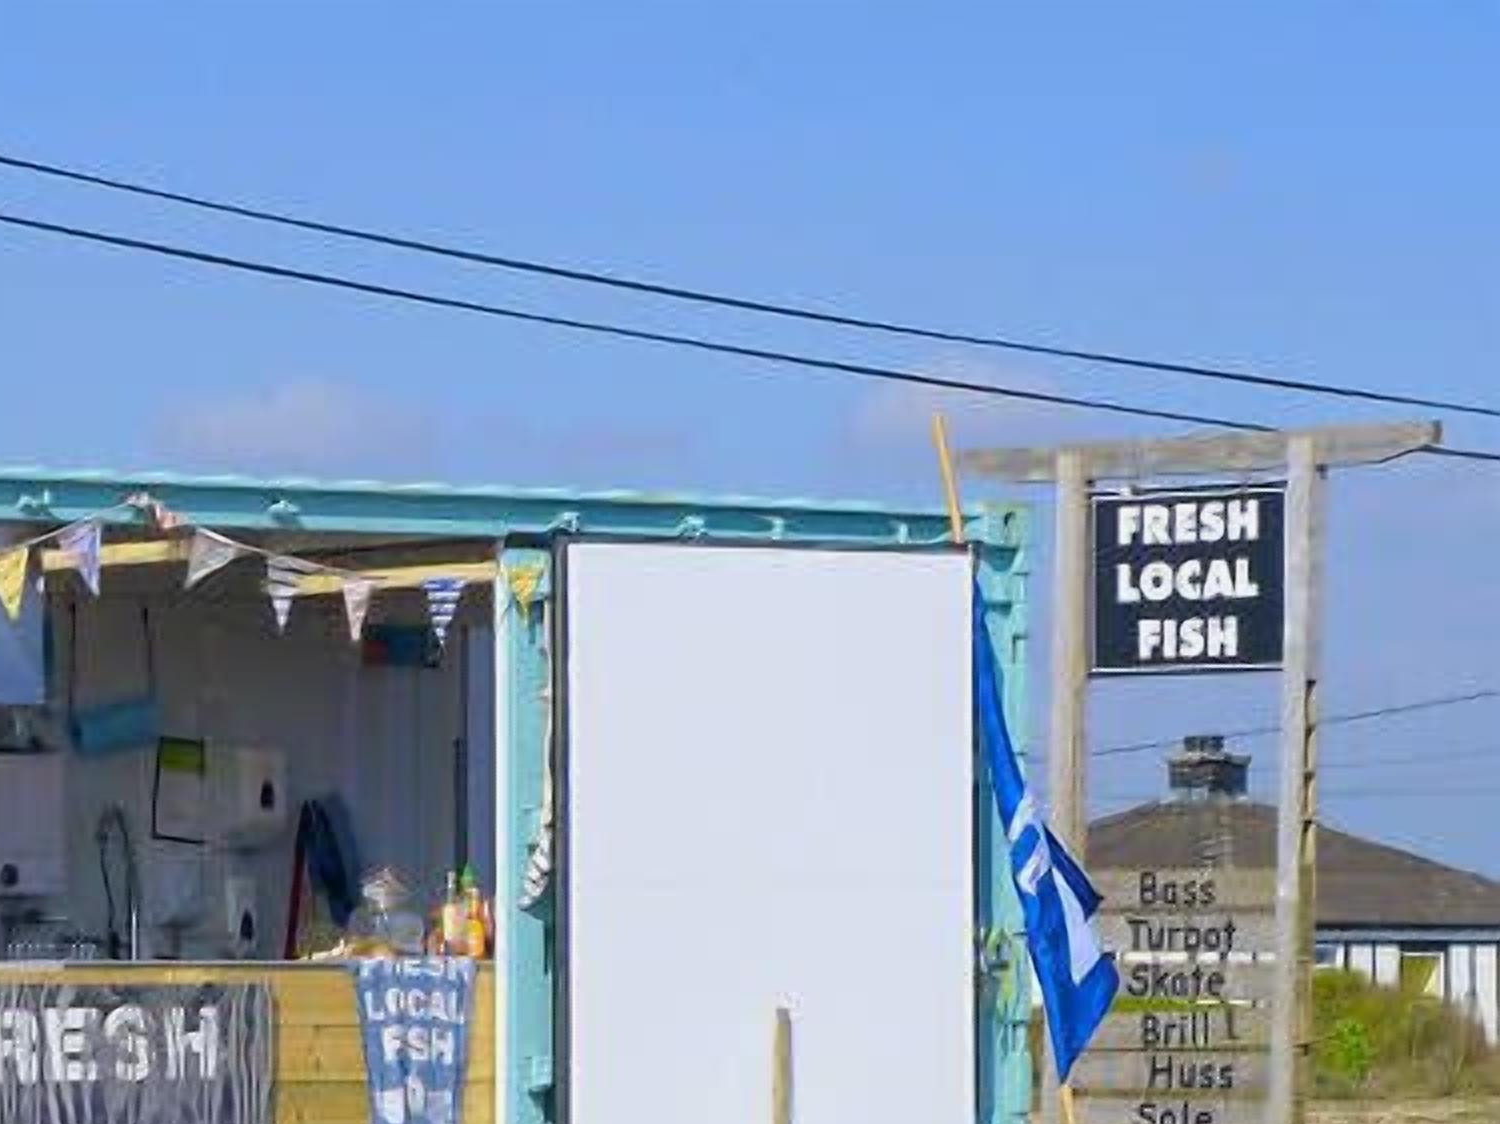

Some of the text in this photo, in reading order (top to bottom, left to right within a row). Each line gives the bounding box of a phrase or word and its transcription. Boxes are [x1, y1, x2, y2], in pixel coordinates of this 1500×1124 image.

[1117, 499, 1260, 546] FRESH
[1116, 557, 1260, 604] LOCAL
[1137, 615, 1239, 660] FISH
[1139, 871, 1217, 906] Bass
[1126, 963, 1225, 997] Skate
[364, 987, 465, 1025] LOCAL
[1140, 1010, 1209, 1046] Brill
[1148, 1054, 1234, 1090] Huss
